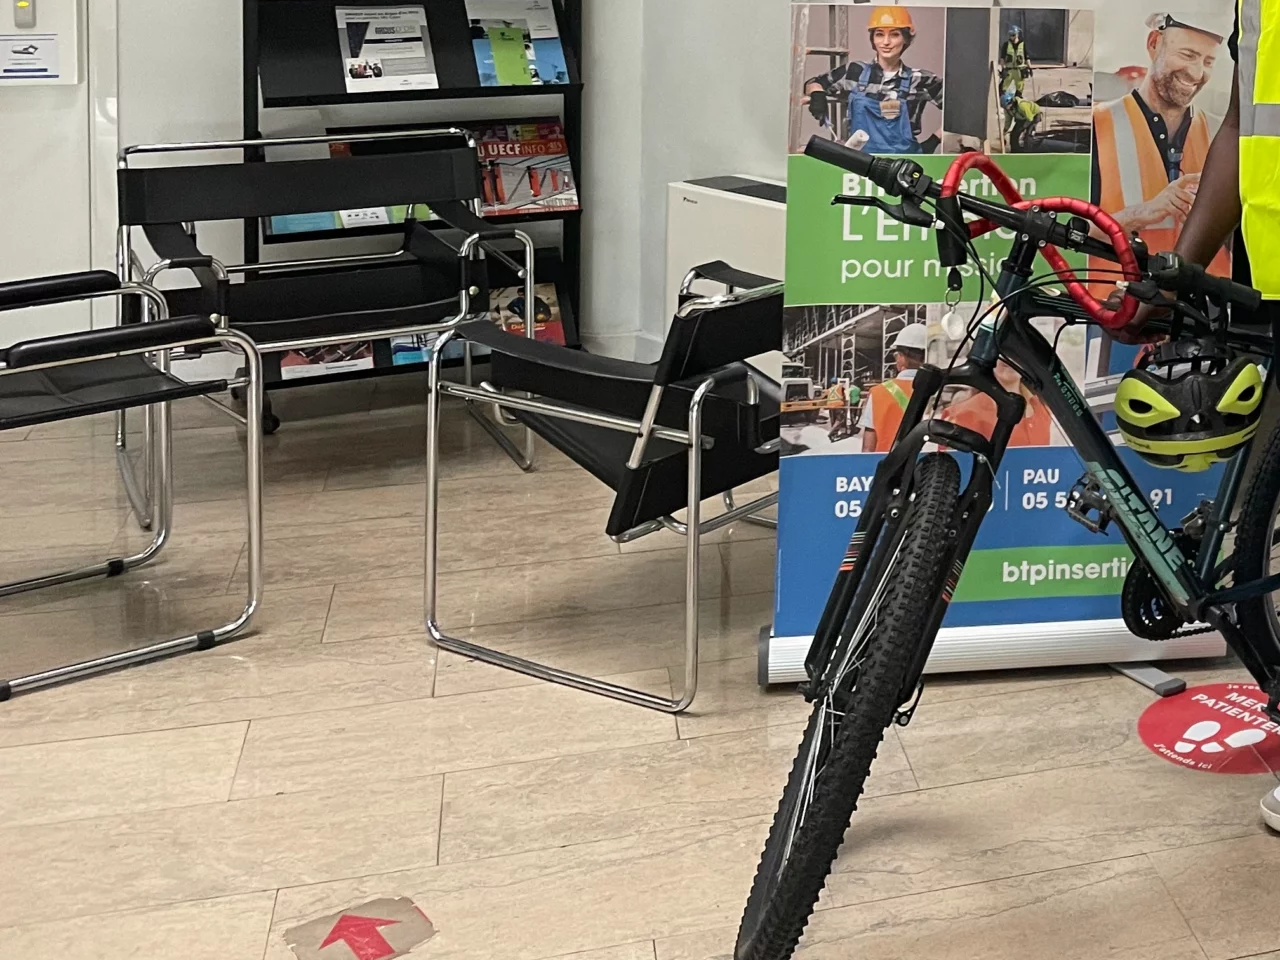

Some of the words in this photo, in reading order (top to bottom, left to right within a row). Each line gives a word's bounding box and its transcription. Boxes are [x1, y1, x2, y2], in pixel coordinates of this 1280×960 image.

[842, 259, 913, 284] pour
[836, 476, 874, 492] BAY
[1023, 469, 1060, 484] PAU
[1022, 492, 1048, 510] 05
[1002, 557, 1132, 585] btpinserti
[1224, 692, 1268, 712] MER
